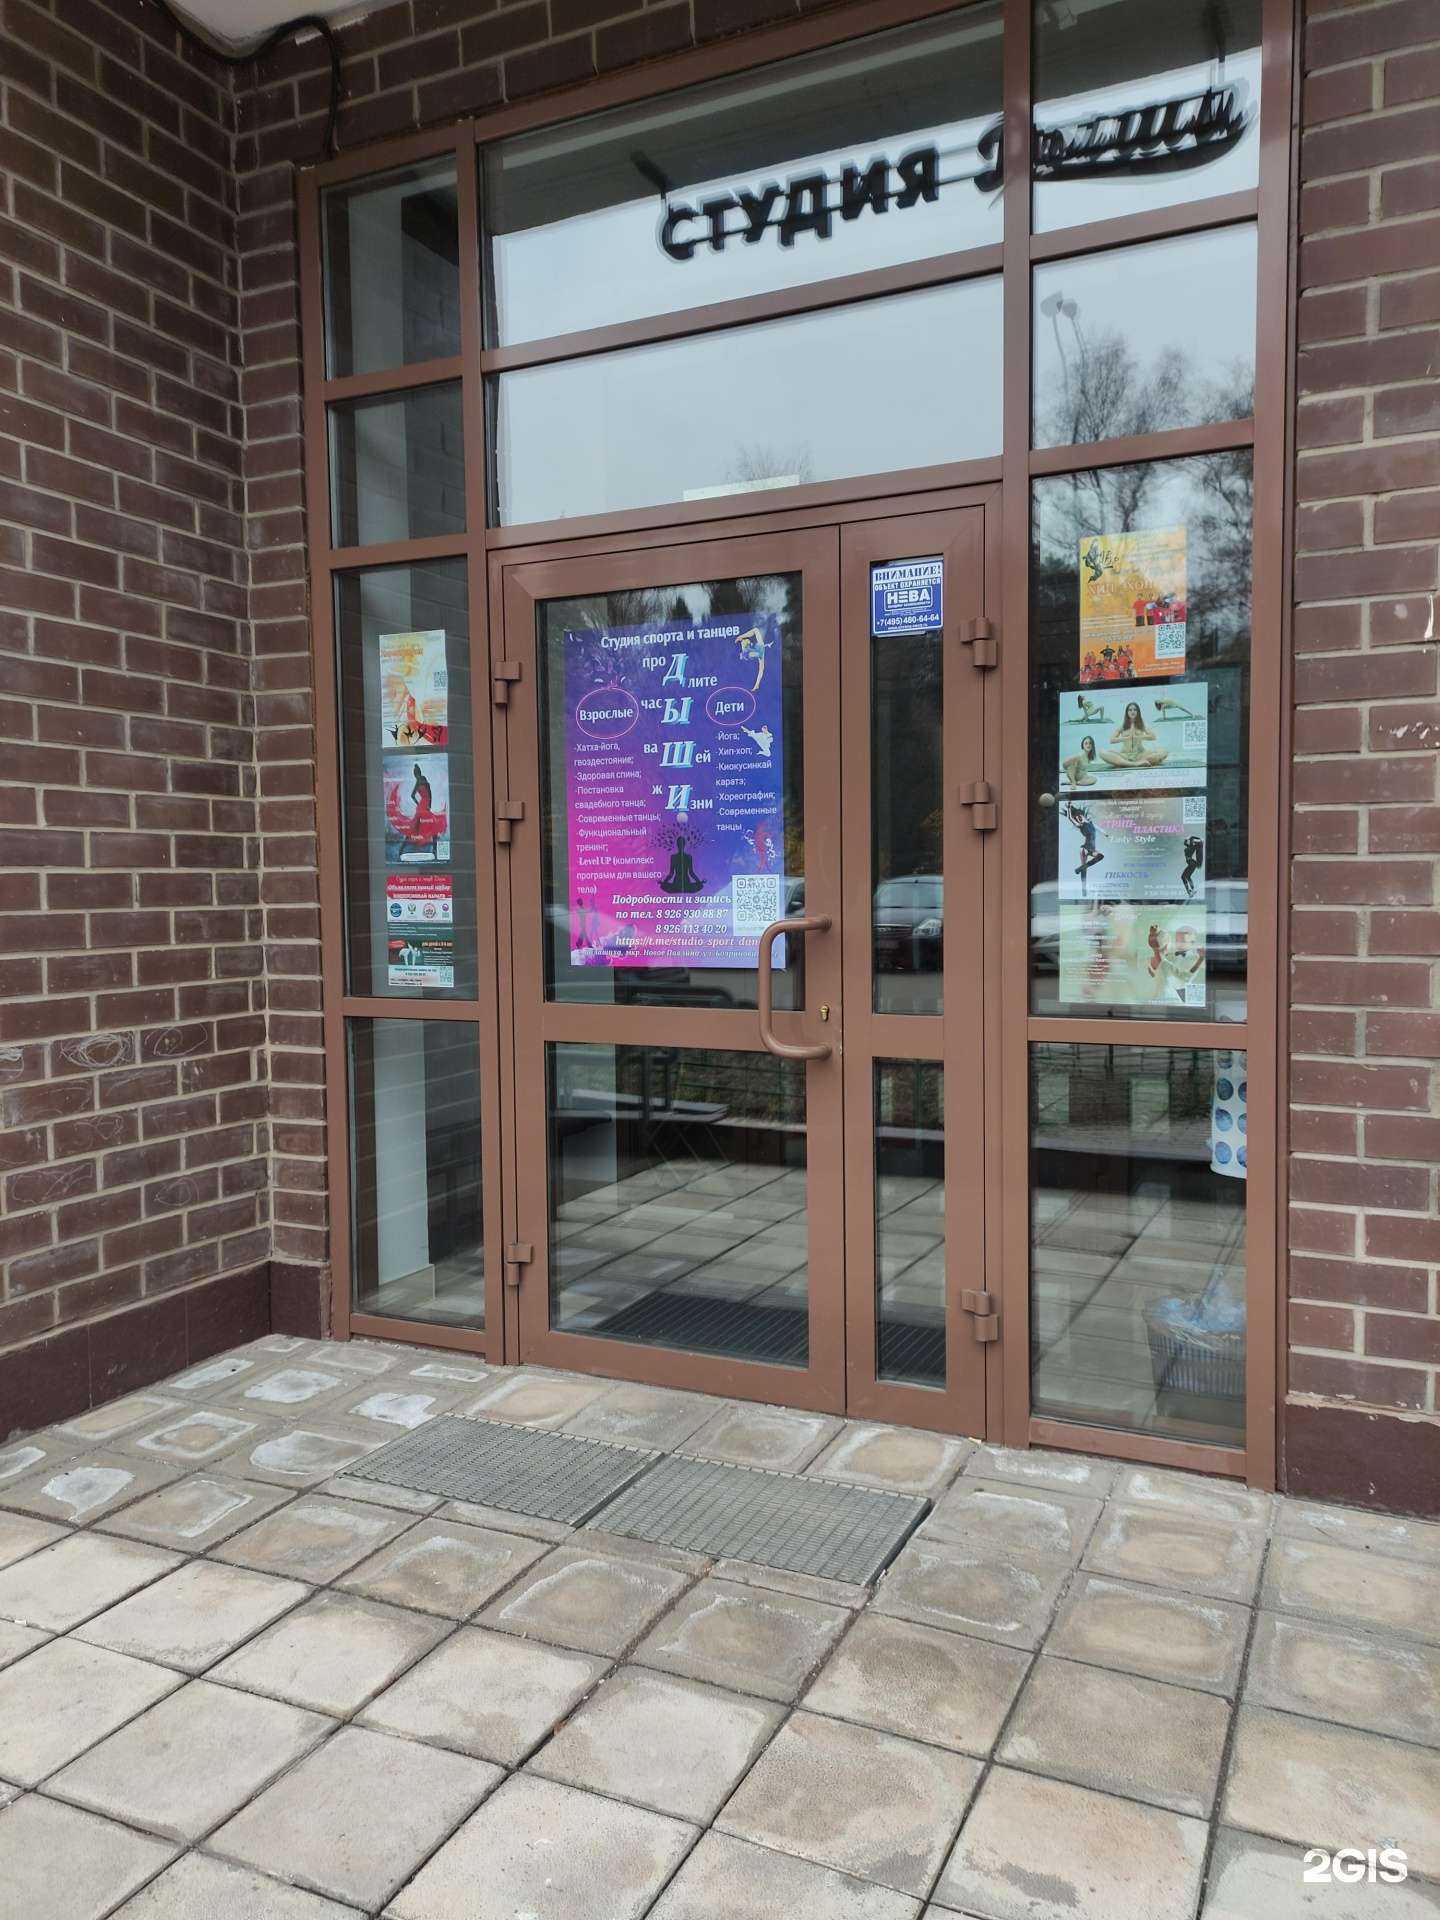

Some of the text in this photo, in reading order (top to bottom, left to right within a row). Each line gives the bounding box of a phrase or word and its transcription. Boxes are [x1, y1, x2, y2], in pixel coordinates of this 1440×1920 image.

[660, 146, 939, 260] СТУДИЯ
[874, 565, 941, 581] ВНИМАНИЕ!
[886, 588, 931, 604] НЕВА
[601, 625, 740, 651] Студия спорта и танцев
[715, 702, 744, 715] Дети
[579, 708, 633, 724] Взрослые
[575, 800, 620, 809] свадебного
[600, 856, 612, 865] UP
[576, 871, 662, 880] программ для вашего
[612, 894, 683, 906] Подробности
[685, 895, 693, 904] и
[615, 911, 629, 919] по
[630, 911, 654, 919] тел.
[655, 909, 663, 919] 8
[664, 909, 681, 919] 926
[683, 909, 700, 919] 930
[655, 925, 662, 934] 8
[663, 925, 681, 934] 926
[615, 936, 760, 948] https://t.me/studio_sport_dan
